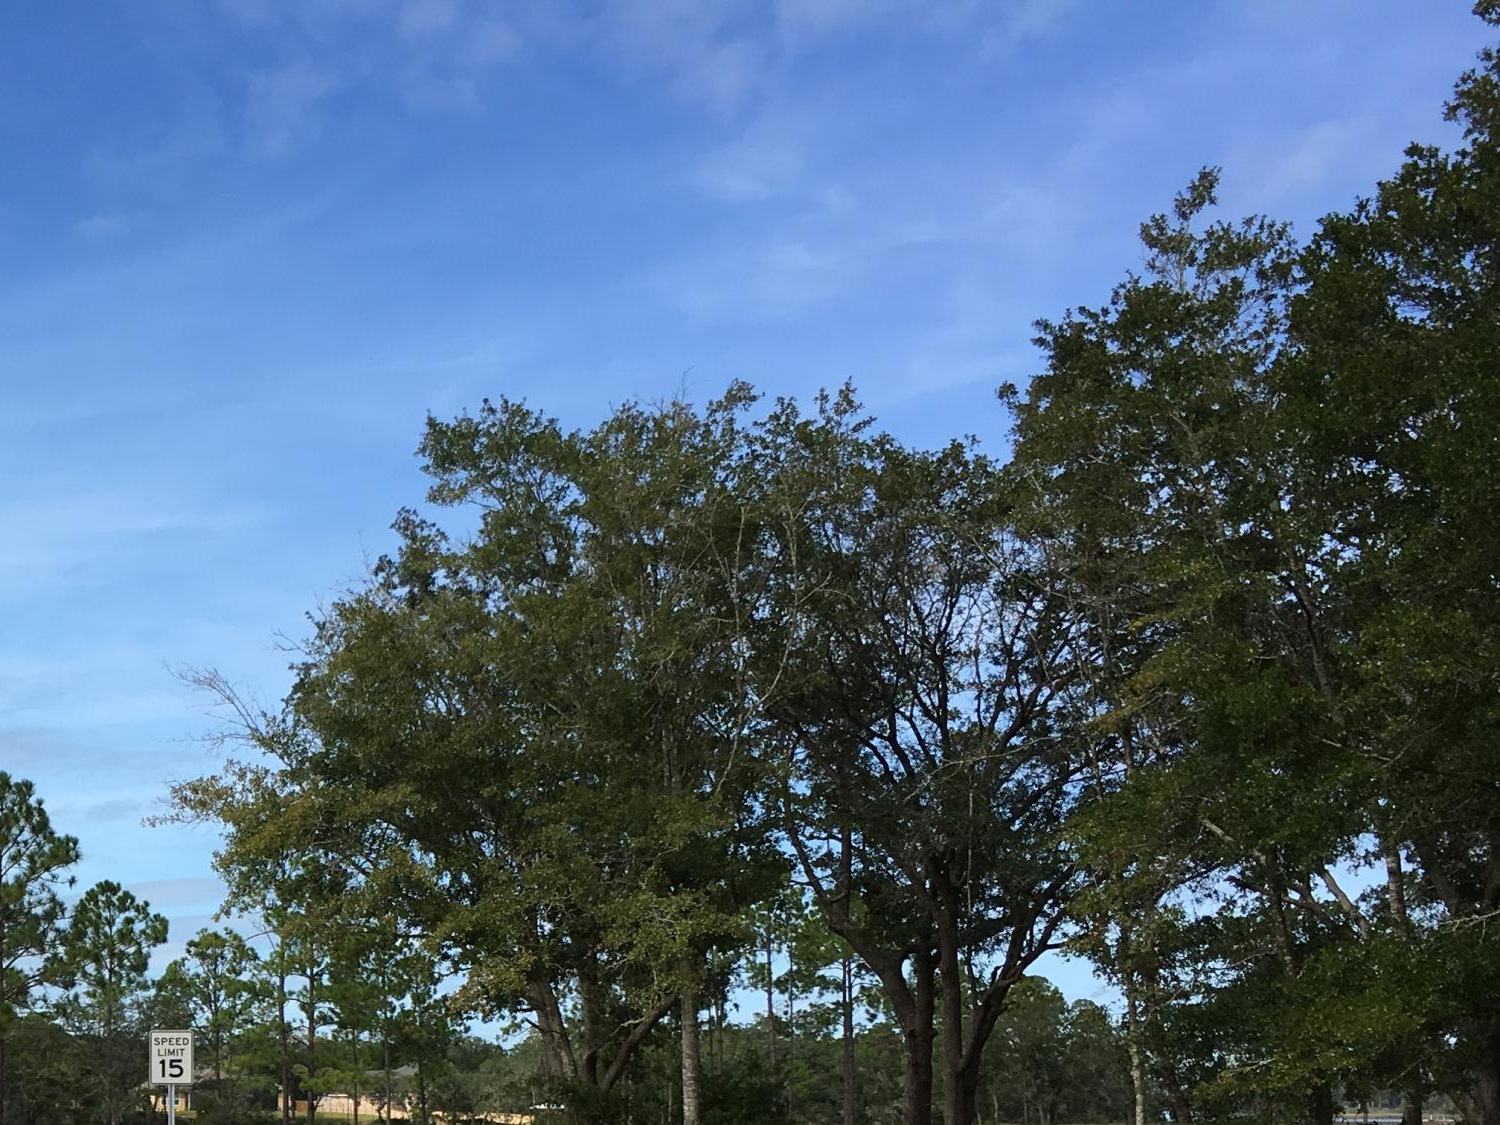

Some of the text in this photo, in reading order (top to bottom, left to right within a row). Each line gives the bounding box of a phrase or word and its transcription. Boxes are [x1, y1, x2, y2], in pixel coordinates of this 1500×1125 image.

[153, 1037, 190, 1046] SPEED
[157, 1048, 186, 1057] LIMIT
[159, 1058, 184, 1078] 15
